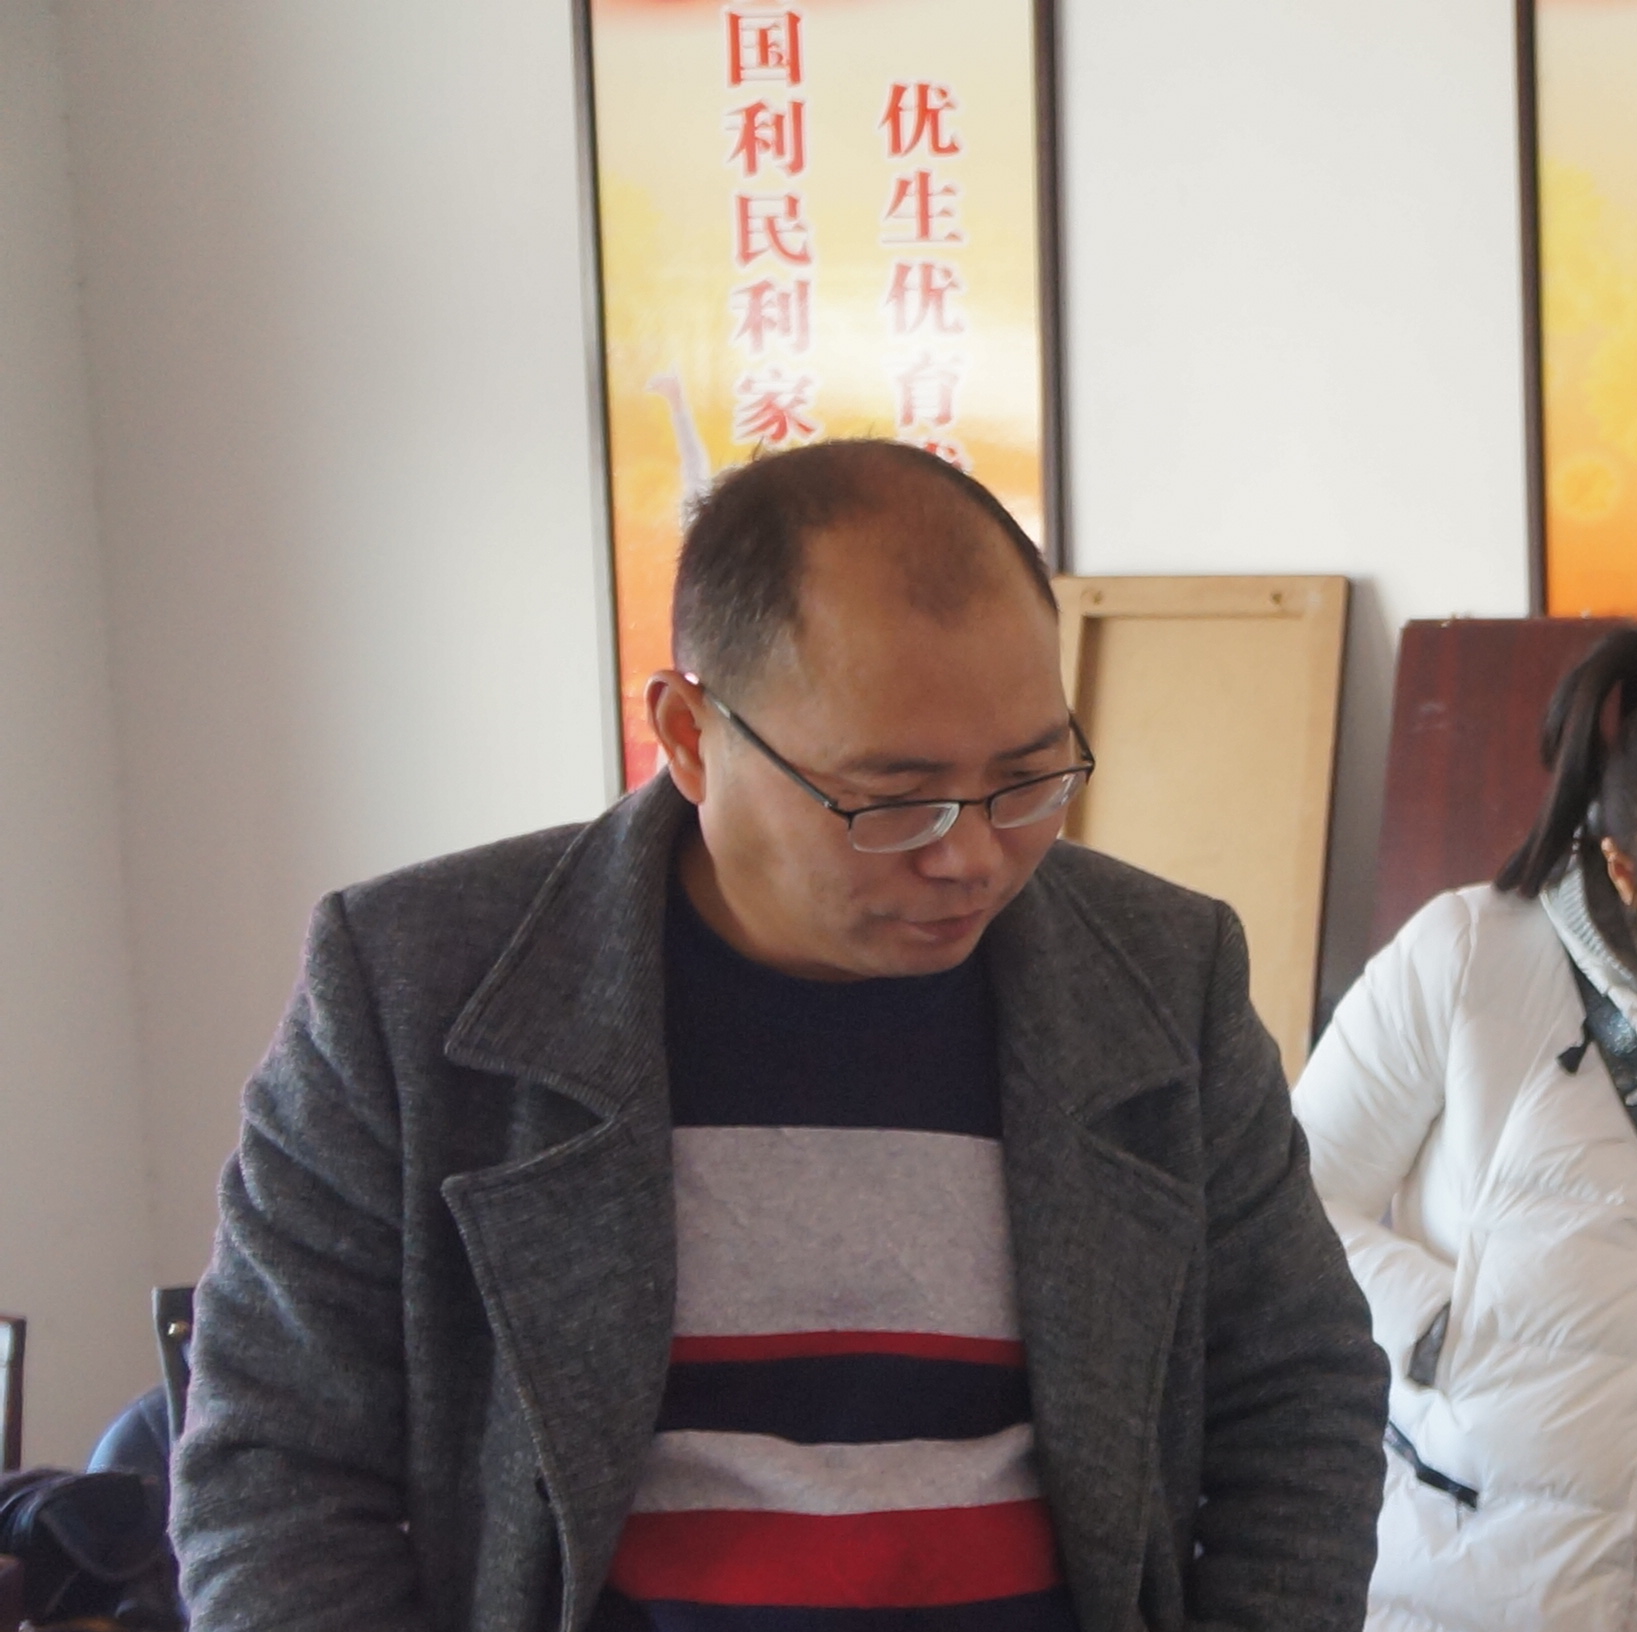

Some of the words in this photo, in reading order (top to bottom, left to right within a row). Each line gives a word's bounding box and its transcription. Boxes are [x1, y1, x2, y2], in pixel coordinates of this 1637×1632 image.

[727, 10, 816, 441] 国利民利家
